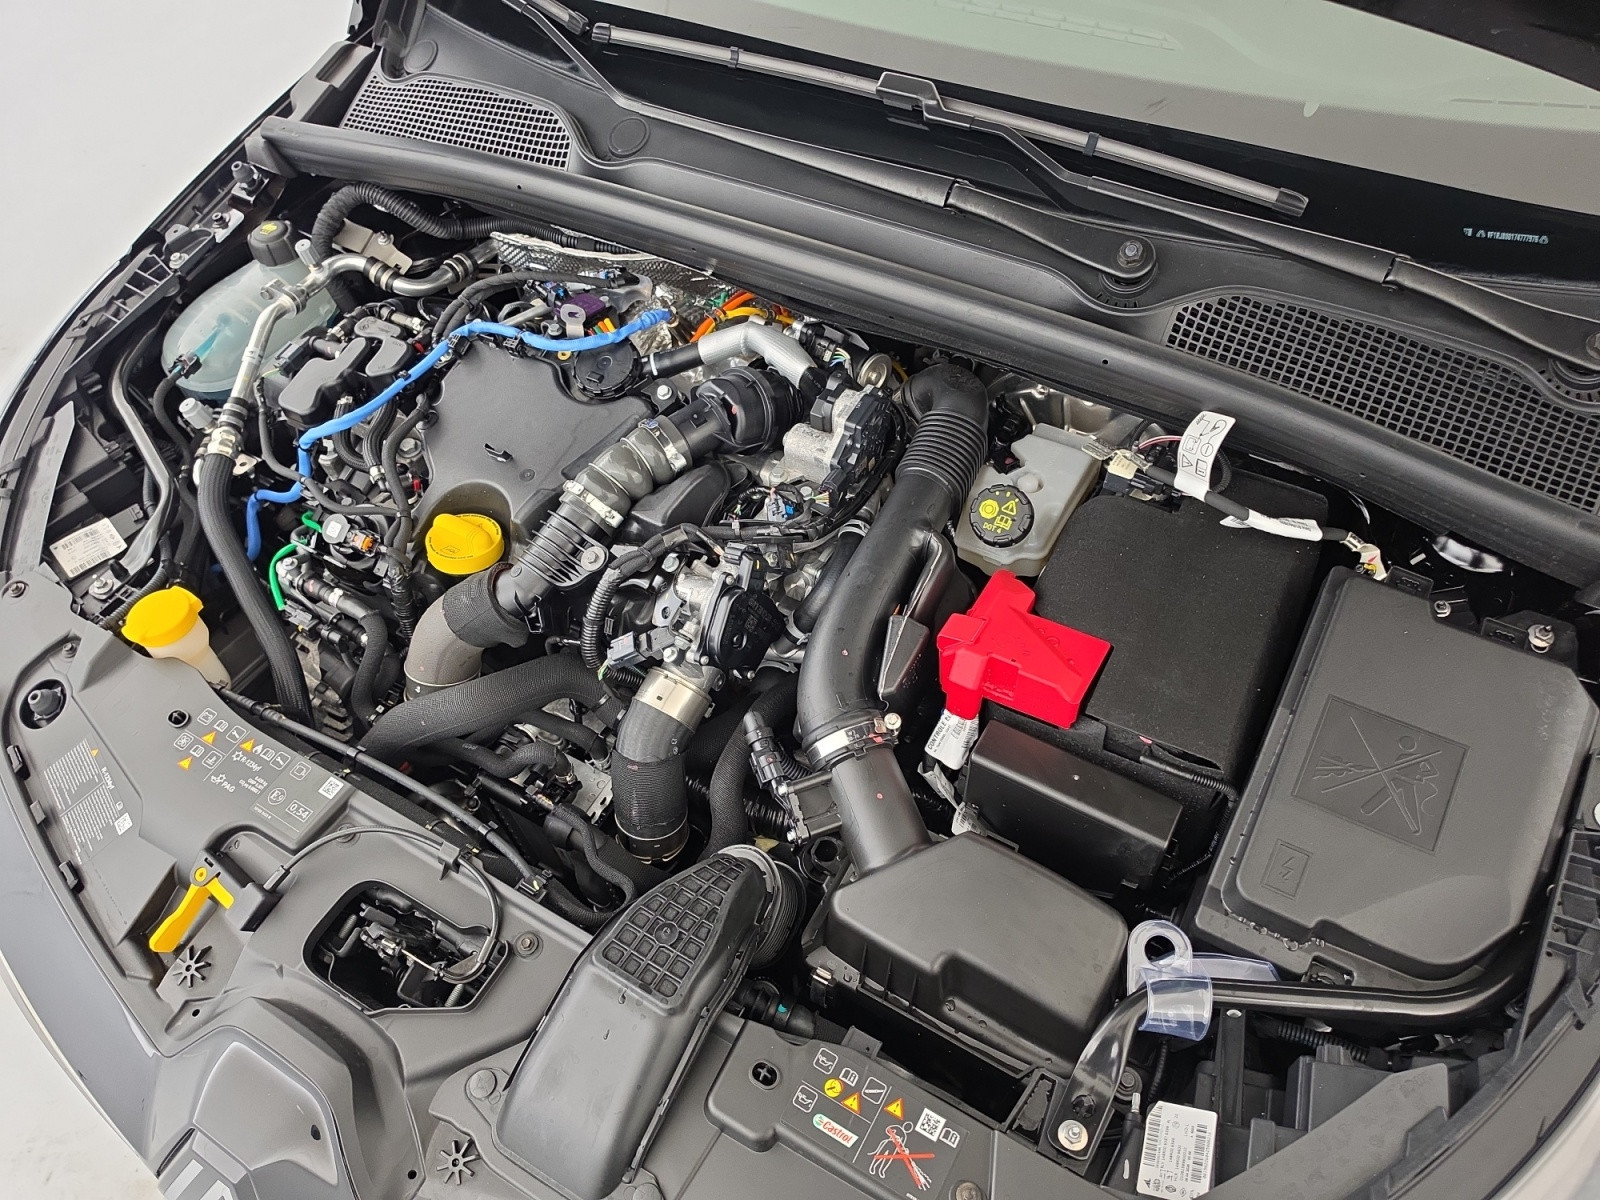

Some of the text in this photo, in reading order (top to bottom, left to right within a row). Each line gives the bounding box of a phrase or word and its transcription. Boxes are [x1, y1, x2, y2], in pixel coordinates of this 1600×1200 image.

[983, 522, 996, 532] DOT
[927, 720, 947, 750] CONTROLE
[240, 756, 261, 772] R-1234yf
[222, 780, 235, 793] PAG
[289, 803, 309, 818] 0,54
[823, 1121, 853, 1144] Castrol
